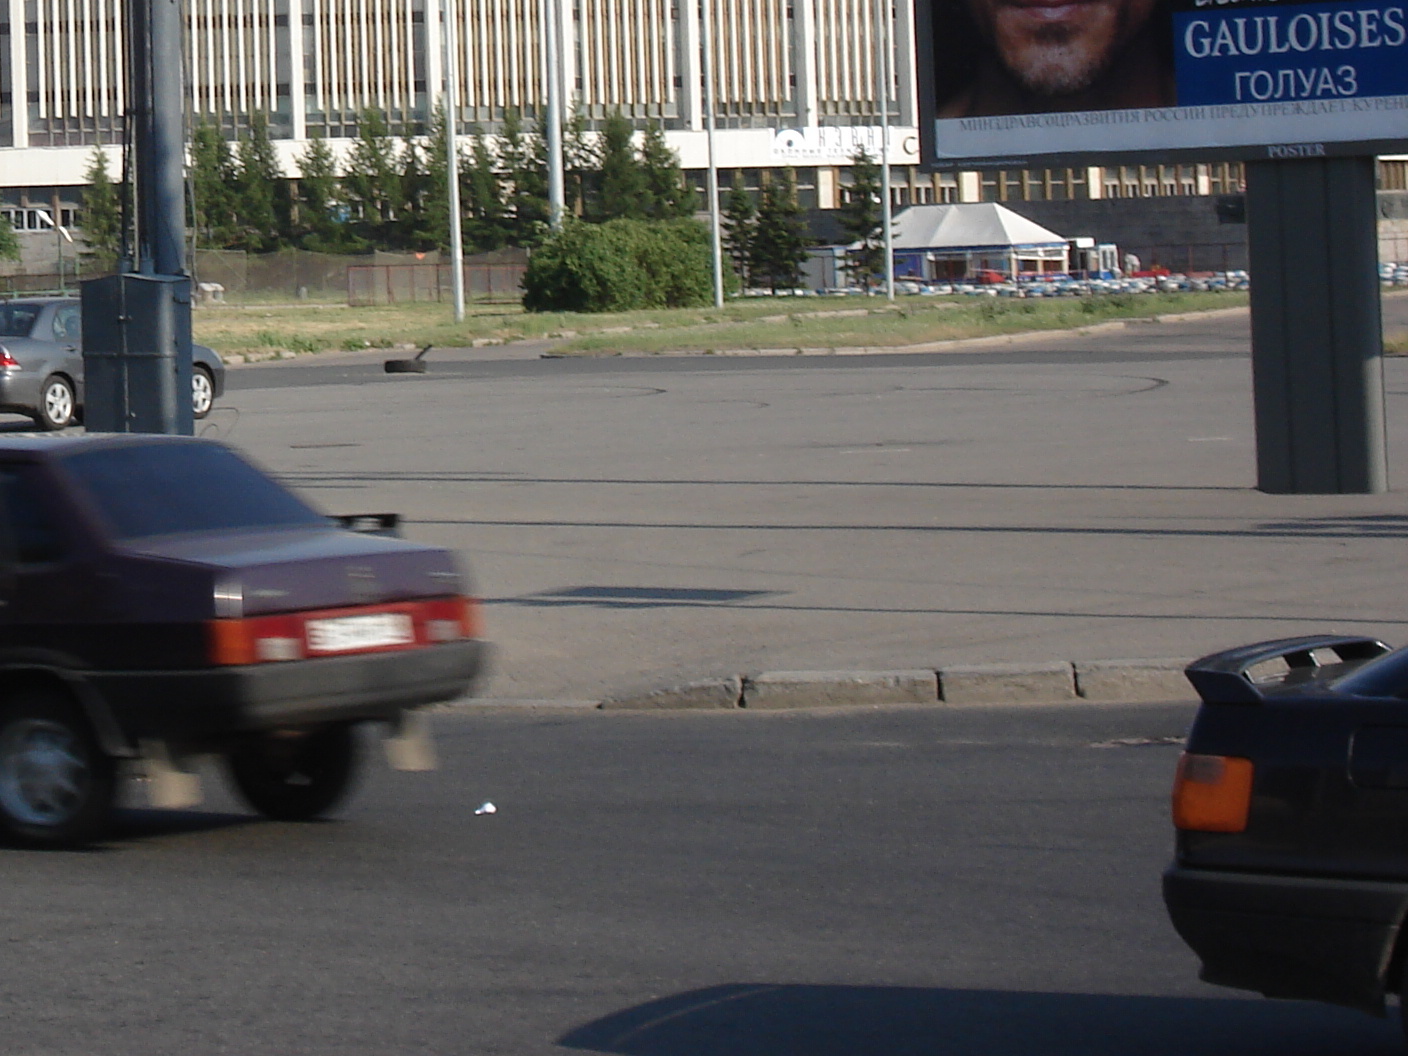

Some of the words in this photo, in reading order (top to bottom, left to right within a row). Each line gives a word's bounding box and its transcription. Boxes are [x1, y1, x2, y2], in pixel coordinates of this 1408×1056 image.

[1184, 8, 1406, 58] GAULOISES
[1235, 65, 1358, 100] ГОЛУАЗ
[959, 110, 1139, 132] МИНЗДРАВСОЦРАЗВИТИЯ
[1144, 106, 1205, 122] РОССИИ
[1210, 100, 1346, 118] ПРЕДУПРЕЖДАЕТ
[1268, 144, 1326, 158] POSTER
